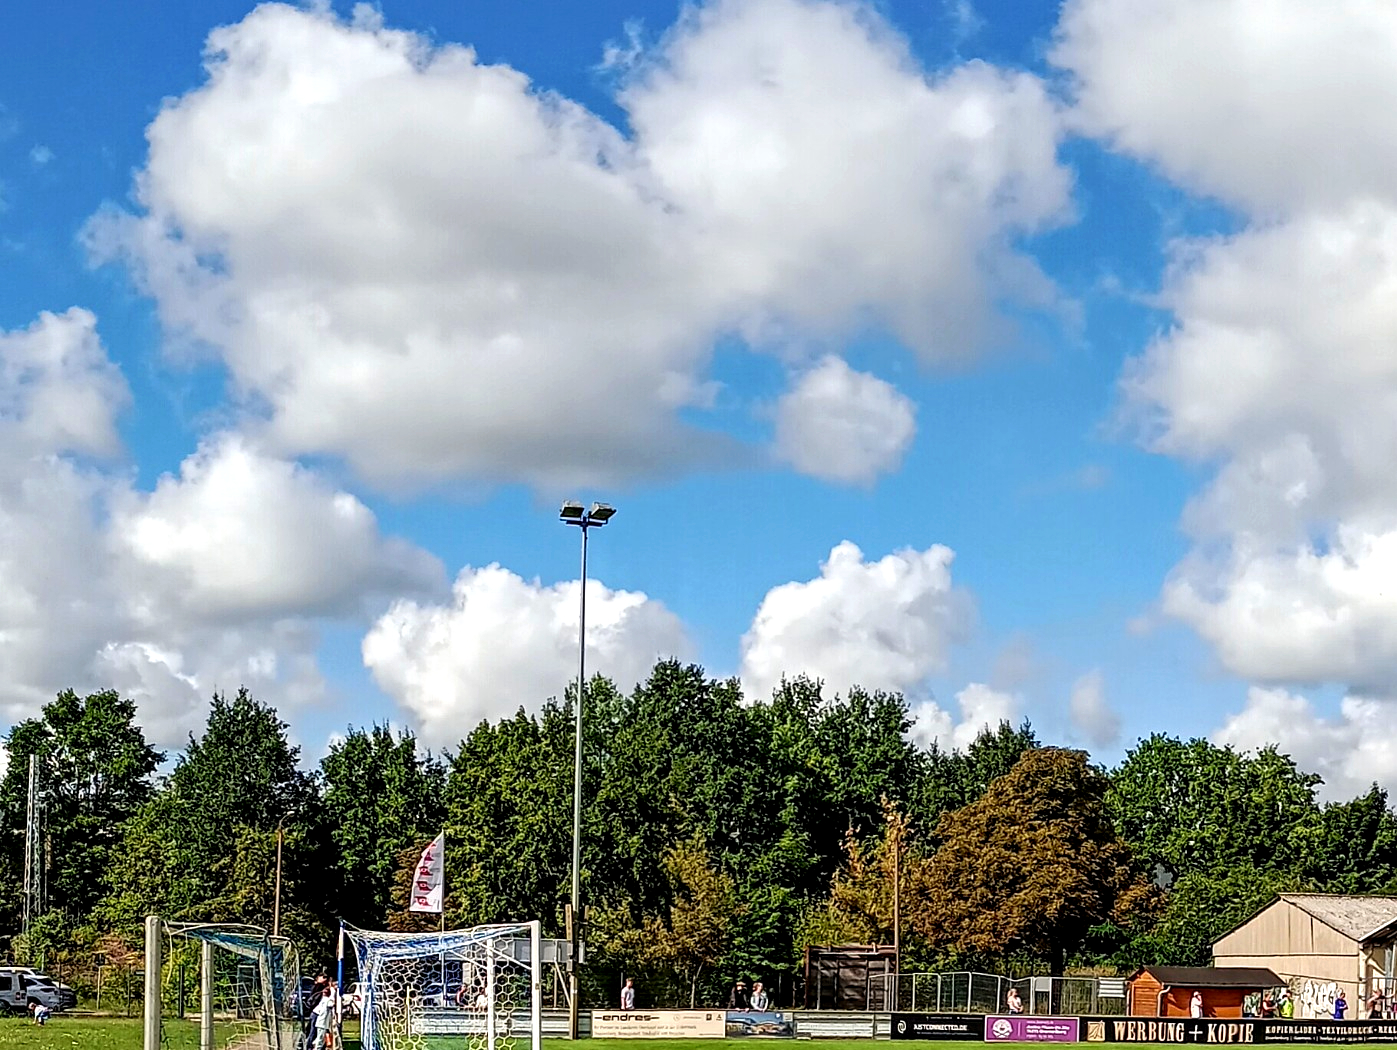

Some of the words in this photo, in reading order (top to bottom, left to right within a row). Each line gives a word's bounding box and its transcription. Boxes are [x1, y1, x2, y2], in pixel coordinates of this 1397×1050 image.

[602, 1013, 651, 1021] endres
[1113, 1021, 1185, 1042] WERBUNG
[1207, 1023, 1254, 1043] KOPIE
